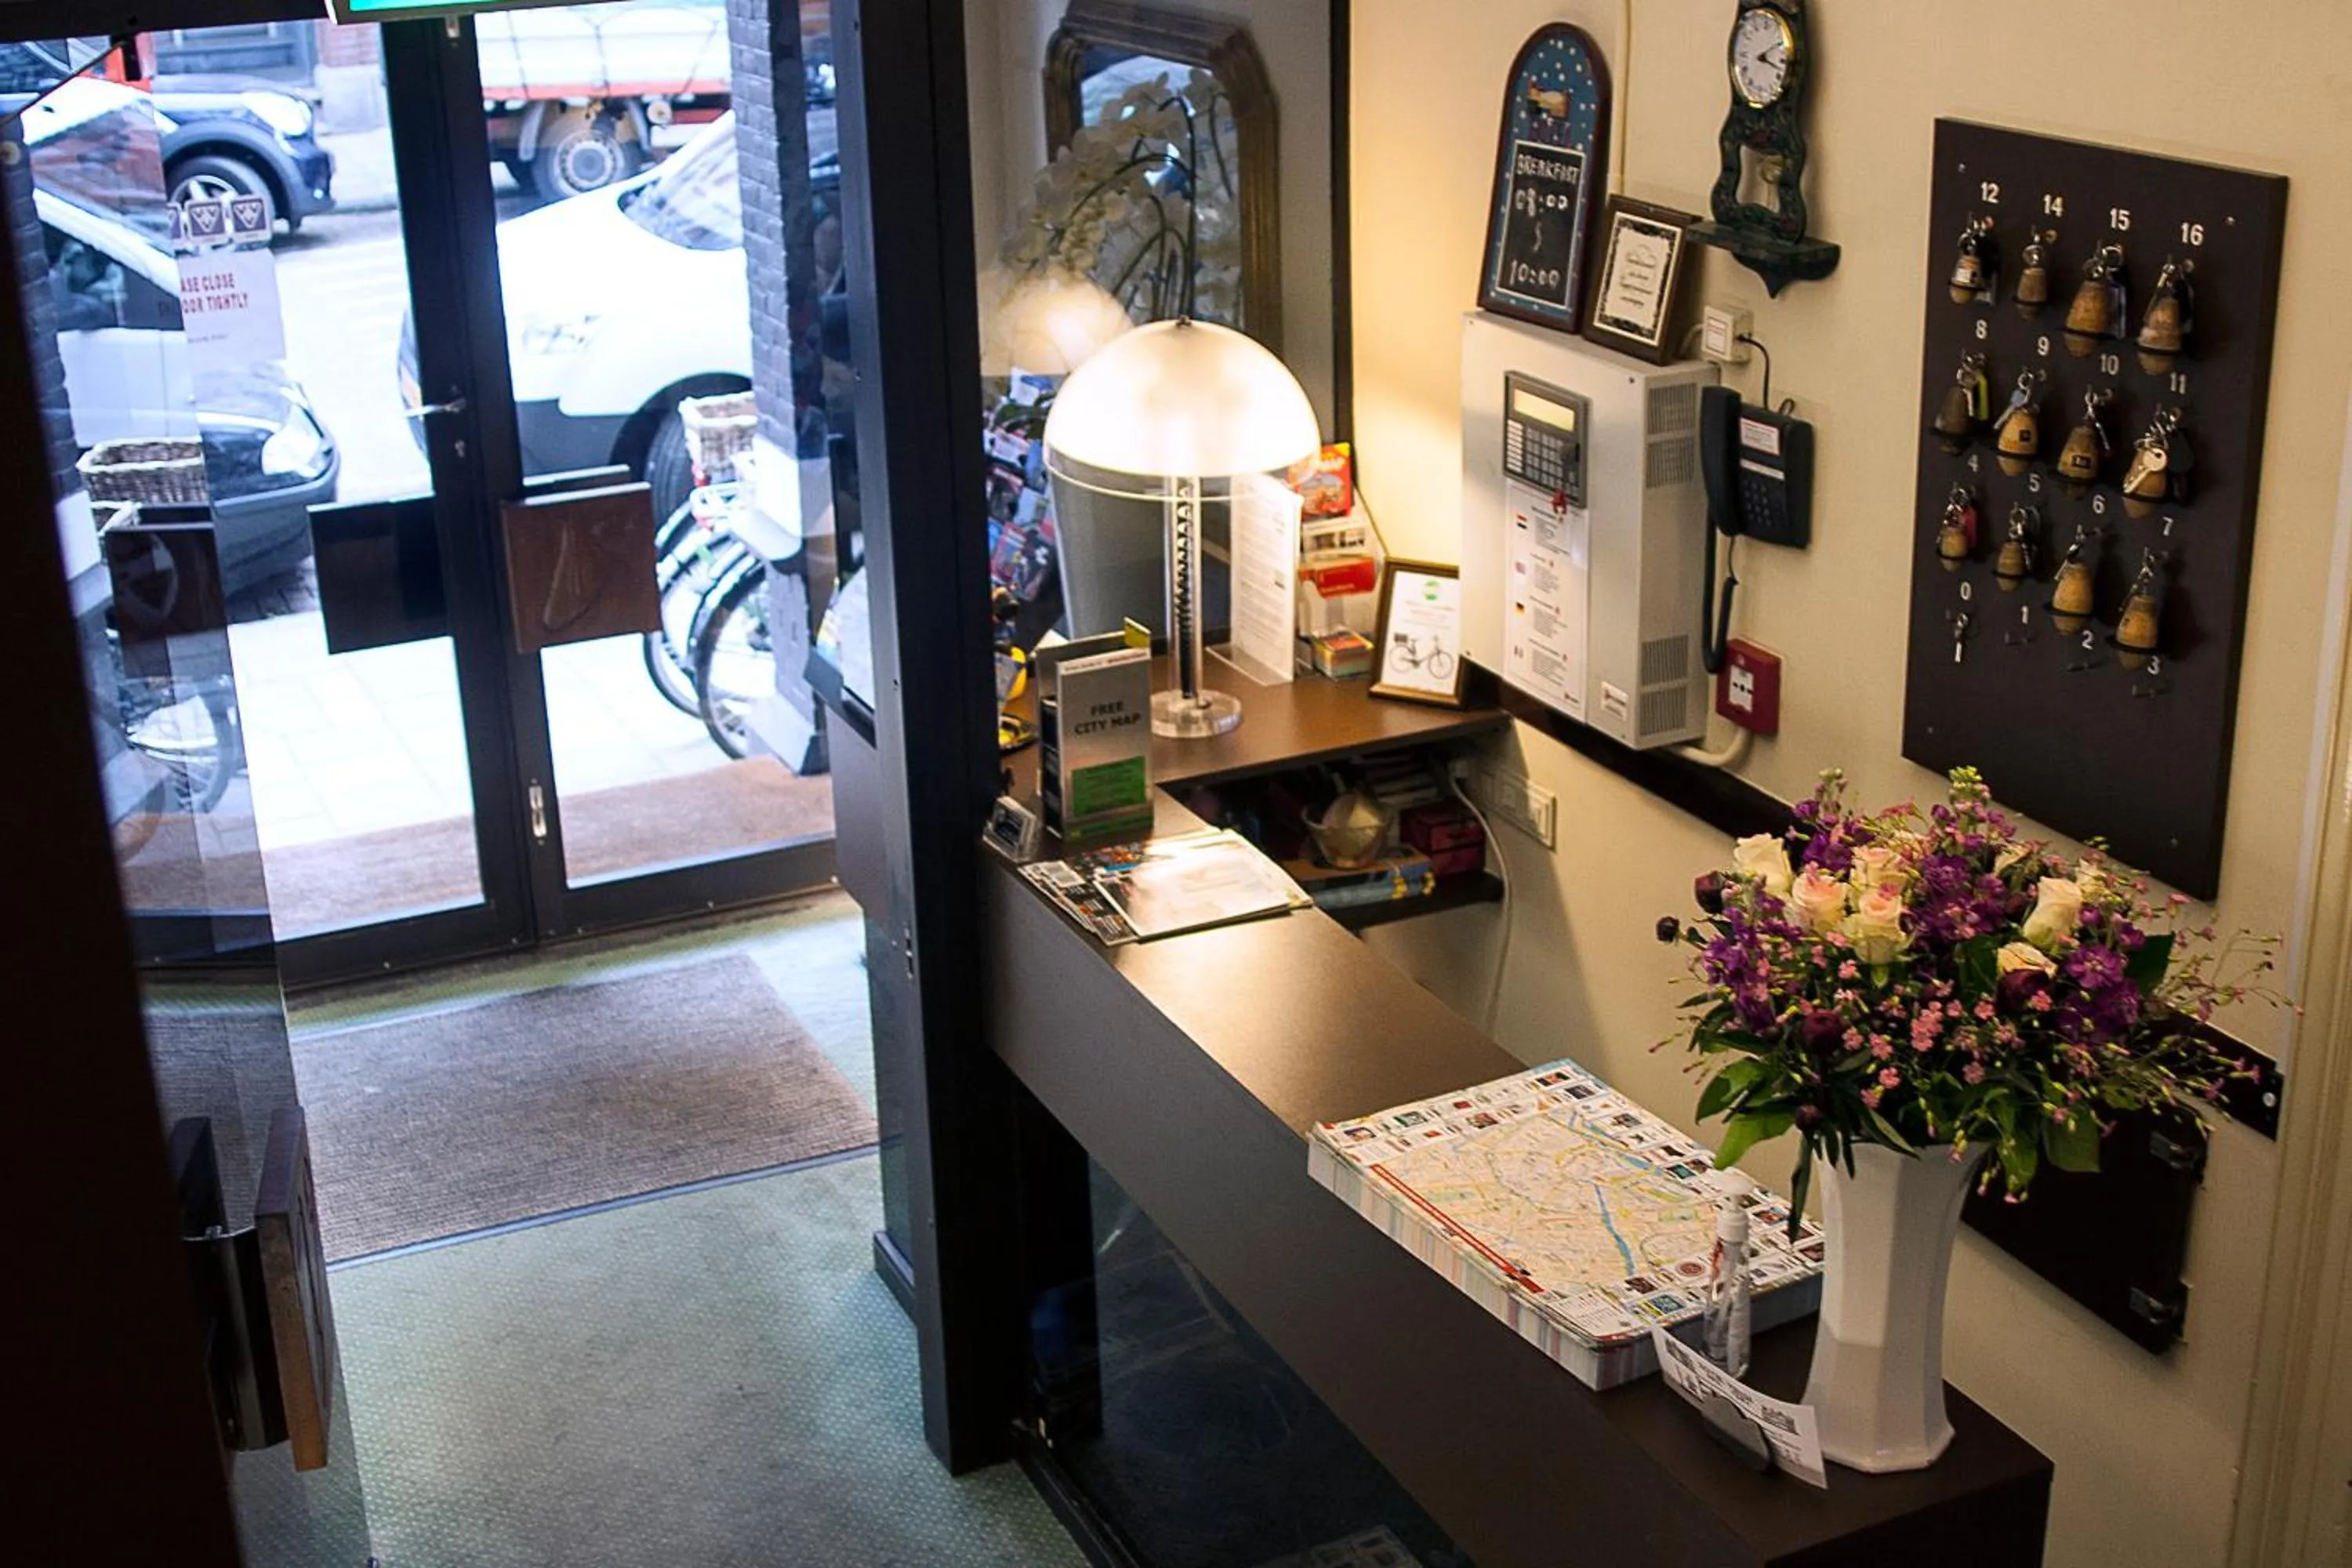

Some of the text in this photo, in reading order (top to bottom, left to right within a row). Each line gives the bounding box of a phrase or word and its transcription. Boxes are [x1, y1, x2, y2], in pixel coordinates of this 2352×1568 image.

[1981, 181, 1999, 204] 12
[2043, 194, 2063, 218] 14
[2110, 208, 2132, 231] 15
[2180, 222, 2205, 246] 16
[1975, 319, 1987, 339] 8
[2038, 336, 2050, 355] 9
[2100, 354, 2119, 376] 10
[2169, 372, 2187, 394] 11
[1967, 454, 1979, 473] 4
[2029, 474, 2040, 492] 5
[2092, 494, 2106, 514] 6
[2162, 516, 2173, 536] 7
[1960, 581, 1972, 601] 0
[2020, 605, 2029, 625] 1
[2082, 630, 2094, 651] 2
[2147, 655, 2161, 675] 3
[1091, 700, 1124, 717] FREE
[1073, 712, 1142, 735] CITY MAP
